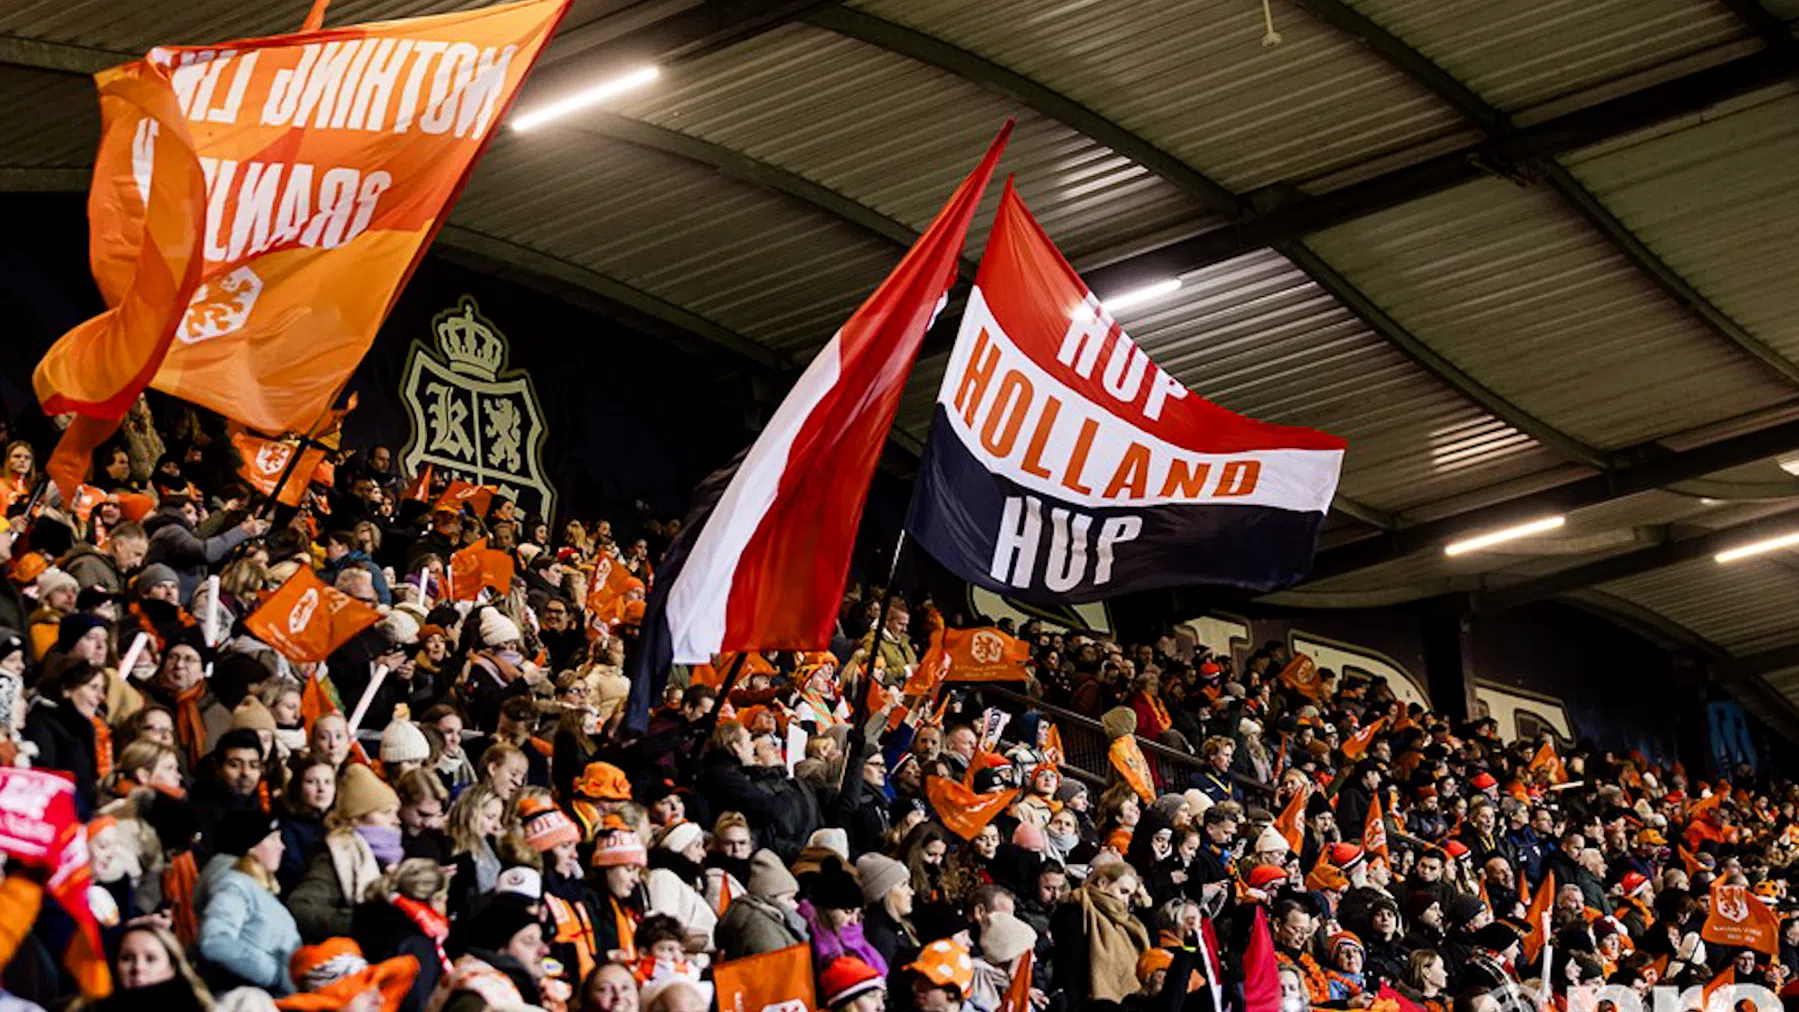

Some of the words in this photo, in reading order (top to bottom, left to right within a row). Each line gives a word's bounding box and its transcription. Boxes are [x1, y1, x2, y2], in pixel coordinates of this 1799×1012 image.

[953, 326, 1262, 499] HOLLAND
[1056, 290, 1189, 423] HUP
[989, 496, 1143, 593] HUP
